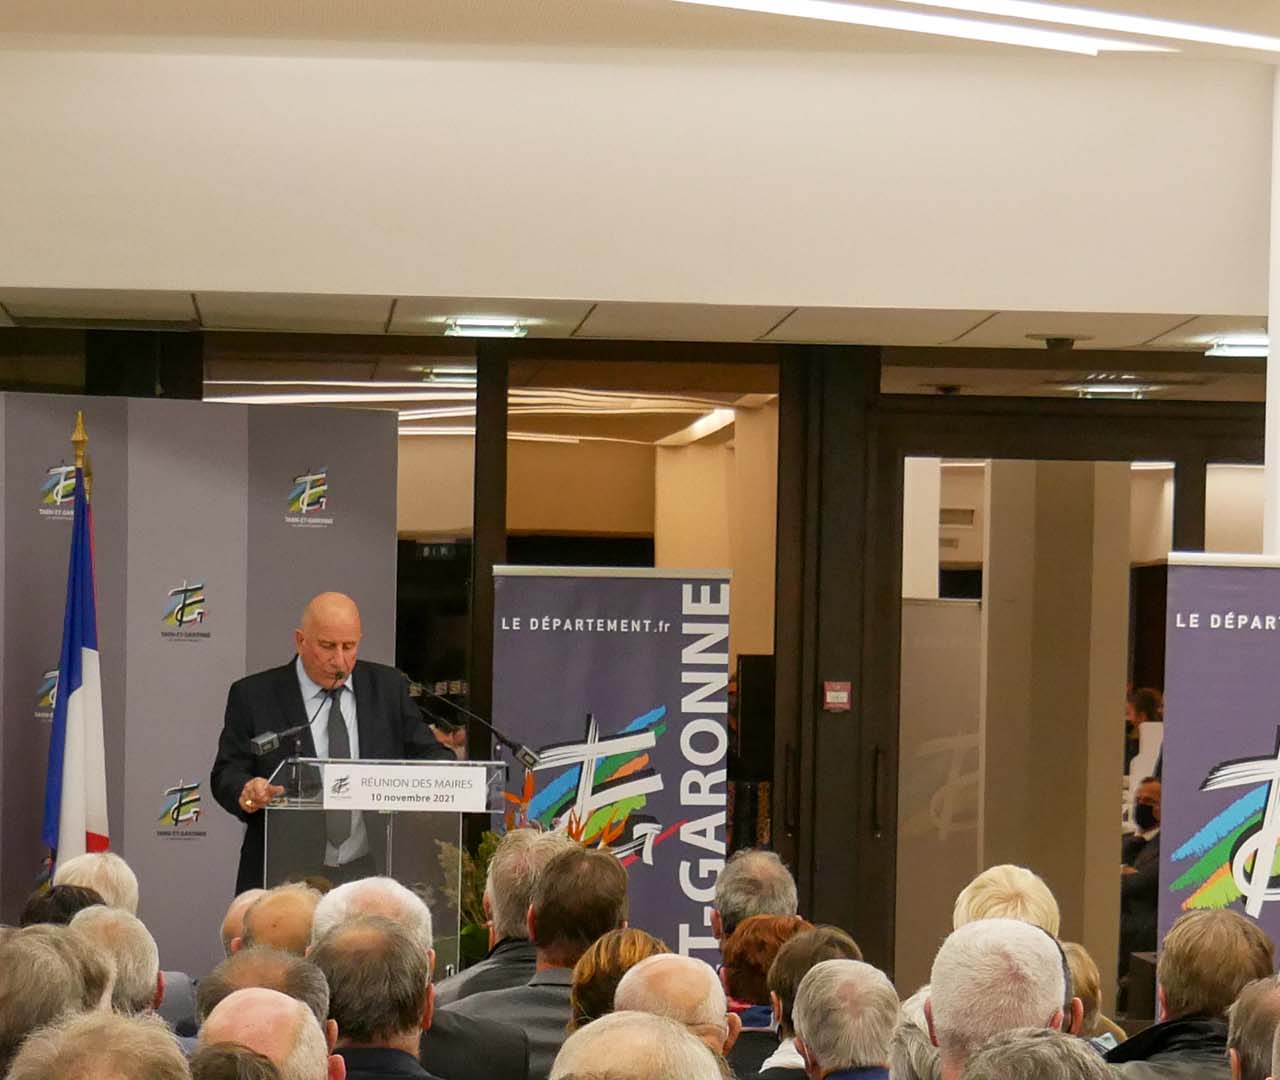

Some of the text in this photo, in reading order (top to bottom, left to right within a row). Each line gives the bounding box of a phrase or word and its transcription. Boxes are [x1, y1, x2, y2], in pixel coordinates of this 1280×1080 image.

[501, 615, 671, 633] LE DÉPARTEMENT.fr
[1176, 613, 1200, 627] LE
[361, 776, 473, 790] RÉUNION DES MAIRES
[371, 792, 455, 803] 10 novembre 2021
